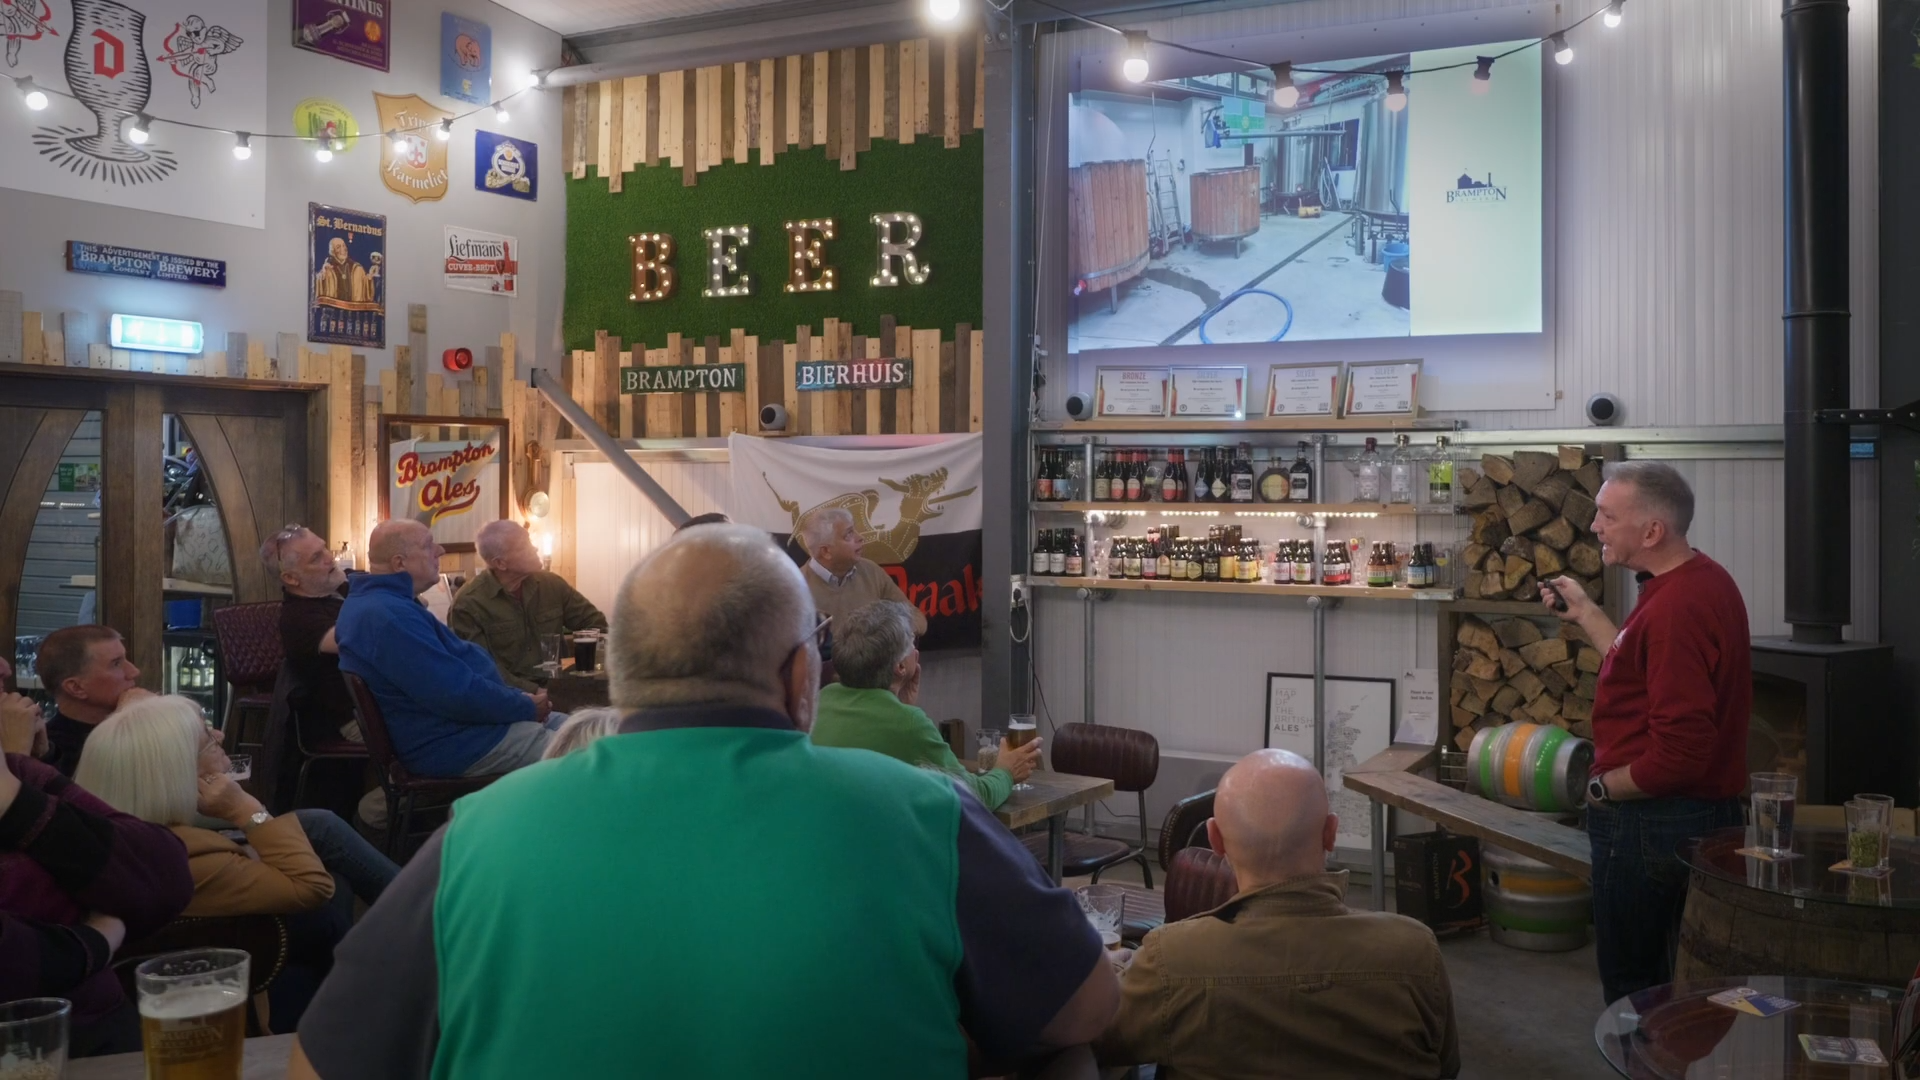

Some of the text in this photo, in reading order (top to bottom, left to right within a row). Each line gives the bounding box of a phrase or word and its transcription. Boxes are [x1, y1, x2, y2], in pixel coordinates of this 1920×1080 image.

[384, 159, 448, 190] Karmeliet
[1446, 186, 1507, 203] BRAMPTON
[316, 215, 383, 236] St. Bernardus
[79, 244, 98, 253] THIS
[102, 246, 161, 261] ADVERTISEMENT
[171, 255, 196, 266] ISSUED
[196, 260, 206, 268] BY
[206, 261, 220, 270] THE
[449, 234, 503, 261] Liefmans
[626, 211, 932, 302] BEER
[79, 251, 220, 279] BRAMPTON BREWERY
[626, 368, 738, 391] BRAMPTON
[801, 363, 906, 386] BIERHUIS
[1121, 371, 1147, 381] BRONZE
[395, 441, 496, 488] Brampton
[418, 475, 478, 511] Ales
[1273, 723, 1300, 732] ALES
[1432, 852, 1440, 900] BRAMPTON
